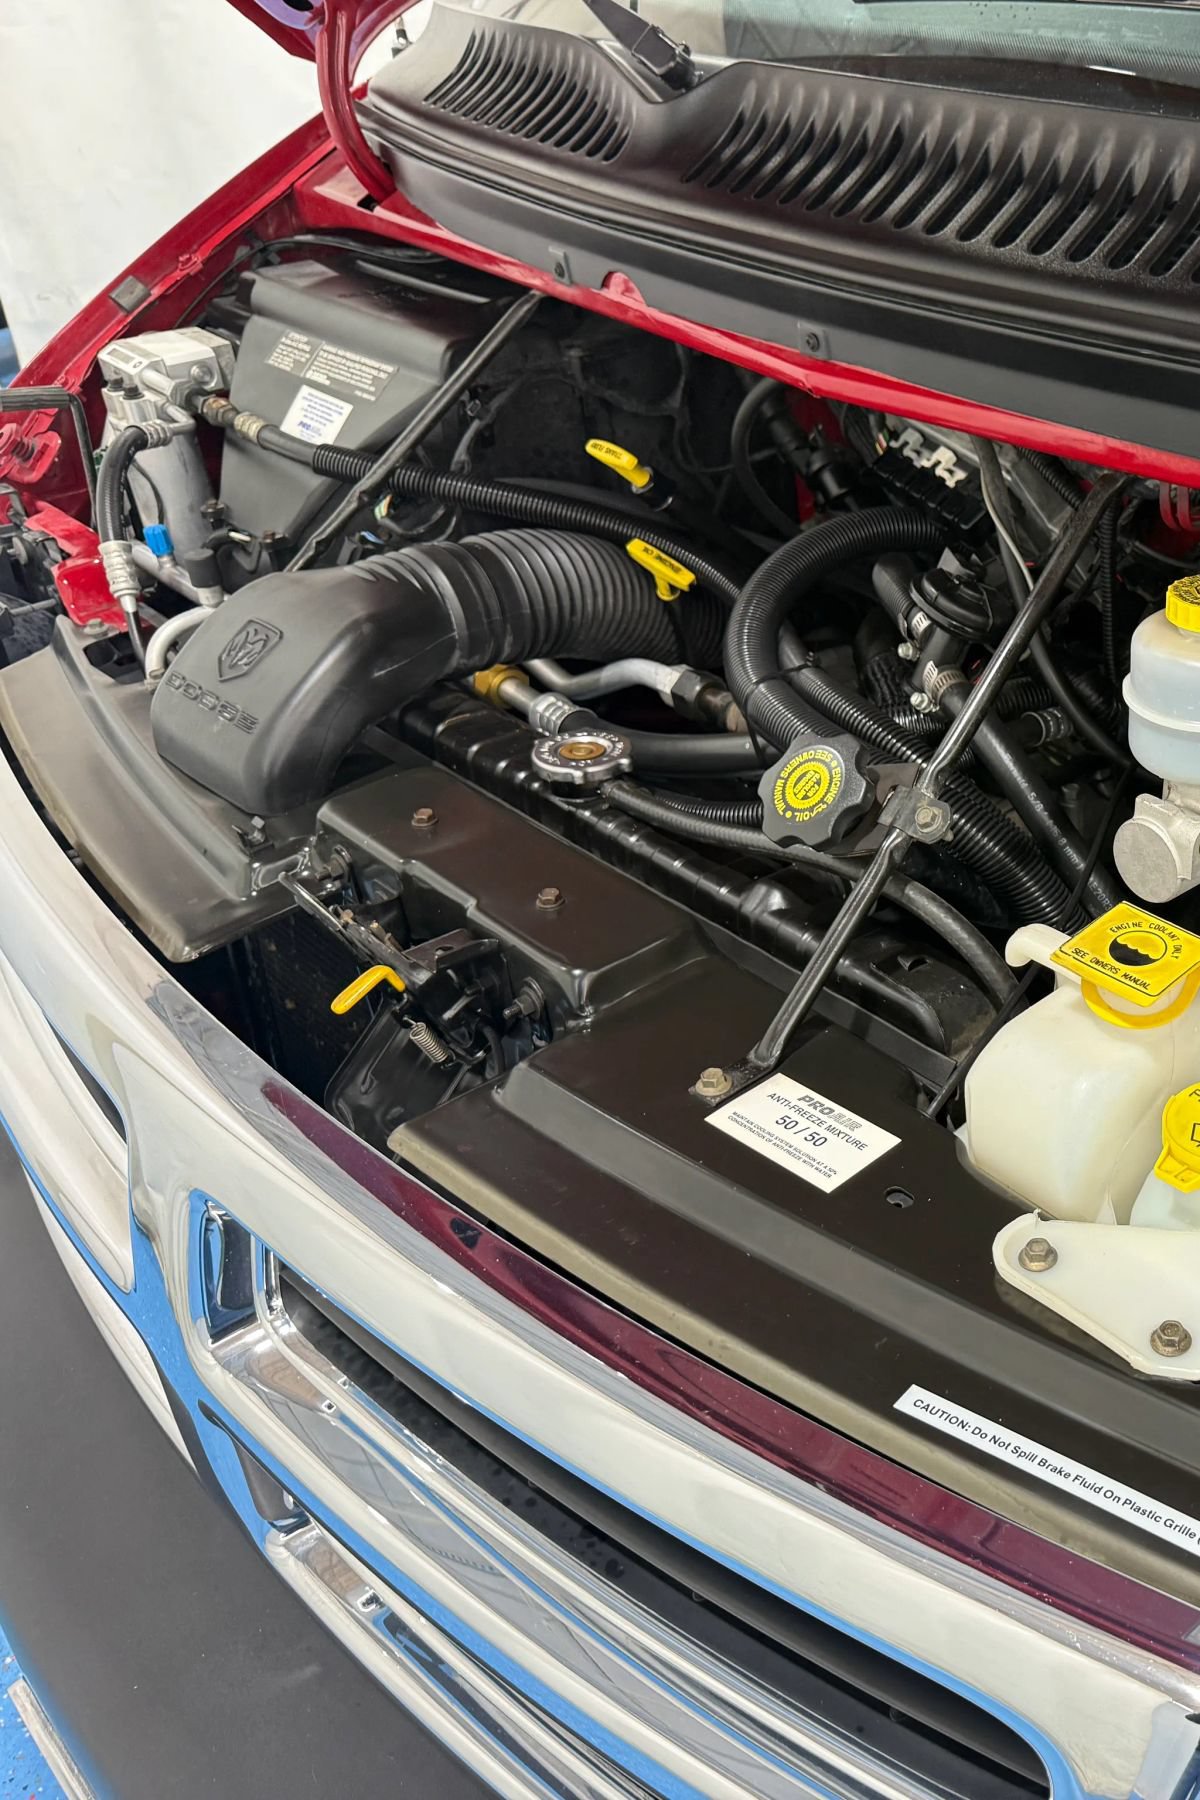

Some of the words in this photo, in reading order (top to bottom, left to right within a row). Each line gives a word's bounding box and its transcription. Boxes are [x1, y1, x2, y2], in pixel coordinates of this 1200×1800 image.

[165, 670, 259, 735] DODGE
[781, 751, 815, 778] OWNERS
[814, 750, 832, 762] SEE
[774, 779, 786, 815] MANUAL
[824, 767, 840, 804] ENGINE
[794, 812, 810, 822] OIL
[1110, 922, 1143, 933] ENGINE
[1149, 923, 1180, 942] COOLANT
[1072, 948, 1088, 959] SEE
[1090, 957, 1120, 975] OWNERS
[1121, 972, 1151, 990] MANUAL
[753, 1122, 774, 1138] COOLING
[773, 1135, 793, 1149] SYSTEM
[767, 1093, 827, 1128] ANTI-FREEZE
[825, 1124, 868, 1151] MIXTURE
[775, 1114, 798, 1130] 50
[794, 1127, 805, 1135] /
[804, 1131, 828, 1147] 50
[813, 1165, 832, 1179] WATER
[913, 1399, 971, 1432] CAUTION:
[971, 1427, 988, 1439] Do
[988, 1435, 1011, 1450] Not
[1011, 1446, 1038, 1463] Spill
[1037, 1458, 1071, 1479] Brake
[1072, 1474, 1103, 1494] Fluid
[1103, 1490, 1121, 1504] On
[1122, 1499, 1163, 1523] Plastic
[1164, 1518, 1197, 1539] Grille
